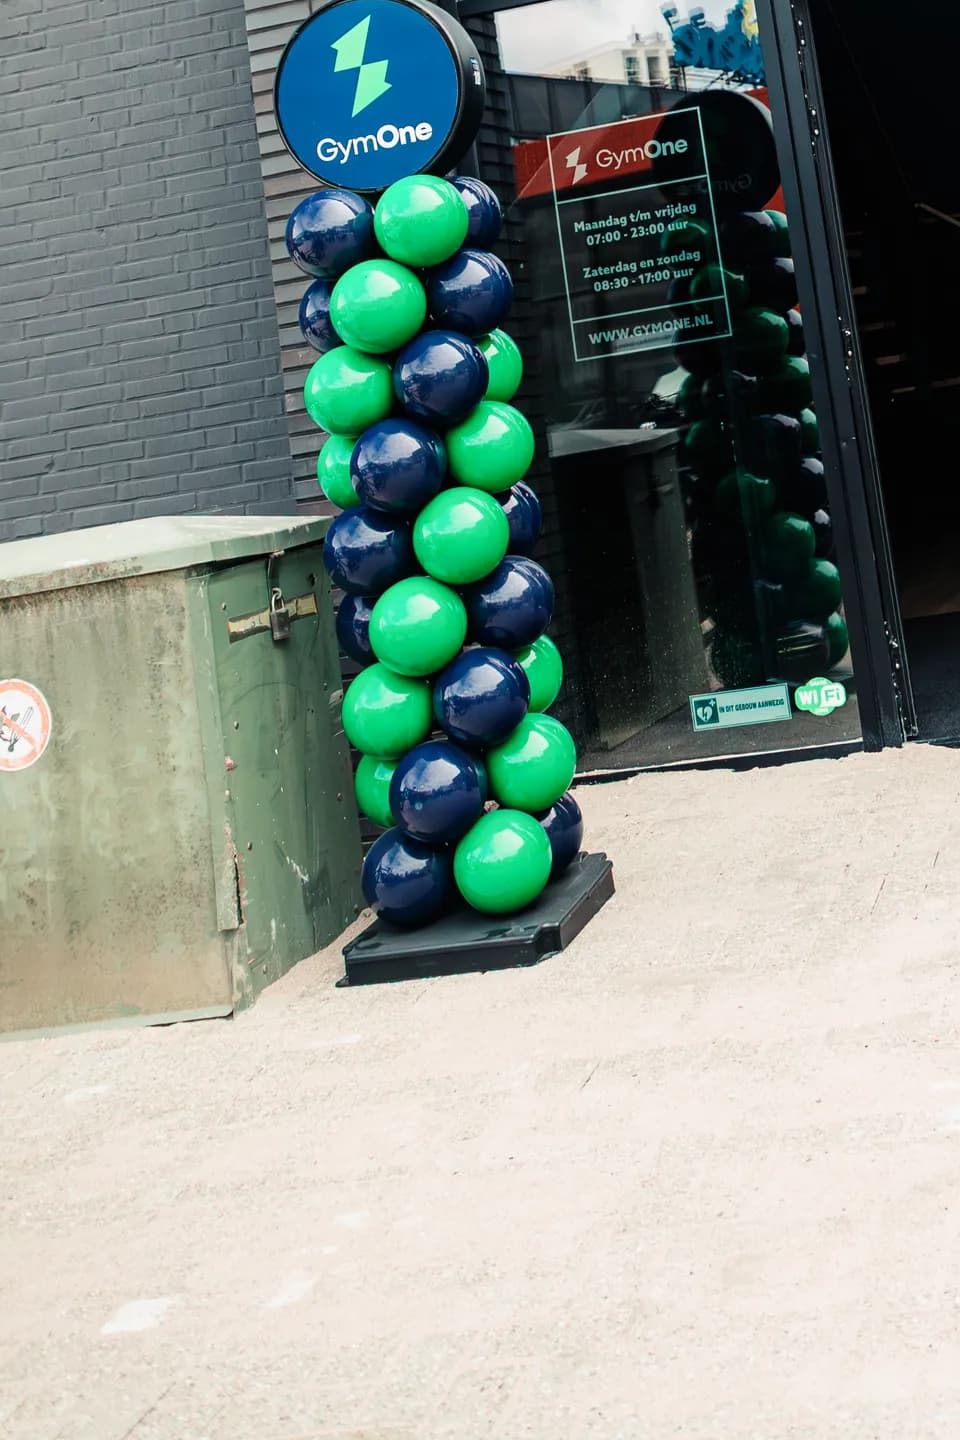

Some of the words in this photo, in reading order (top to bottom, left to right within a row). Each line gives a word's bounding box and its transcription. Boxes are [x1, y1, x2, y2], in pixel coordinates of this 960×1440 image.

[316, 121, 433, 164] GymOne
[596, 139, 688, 170] GymOne
[574, 215, 627, 232] Maandag
[629, 210, 651, 222] t/m
[654, 202, 697, 218] vrijdag
[586, 230, 621, 246] 07:00
[630, 222, 665, 238] 23:00
[667, 220, 689, 231] uur
[582, 261, 637, 278] Zaterdag
[640, 259, 654, 268] en
[656, 250, 701, 265] zondag
[593, 276, 629, 292] 08:30
[638, 269, 670, 284] 17:00
[673, 267, 694, 279] uur
[588, 314, 713, 344] WWW.GYMONE.NL
[719, 705, 725, 713] IN
[725, 704, 734, 712] DIT
[735, 702, 757, 711] GEBOUW
[757, 698, 785, 708] AANWEZIG
